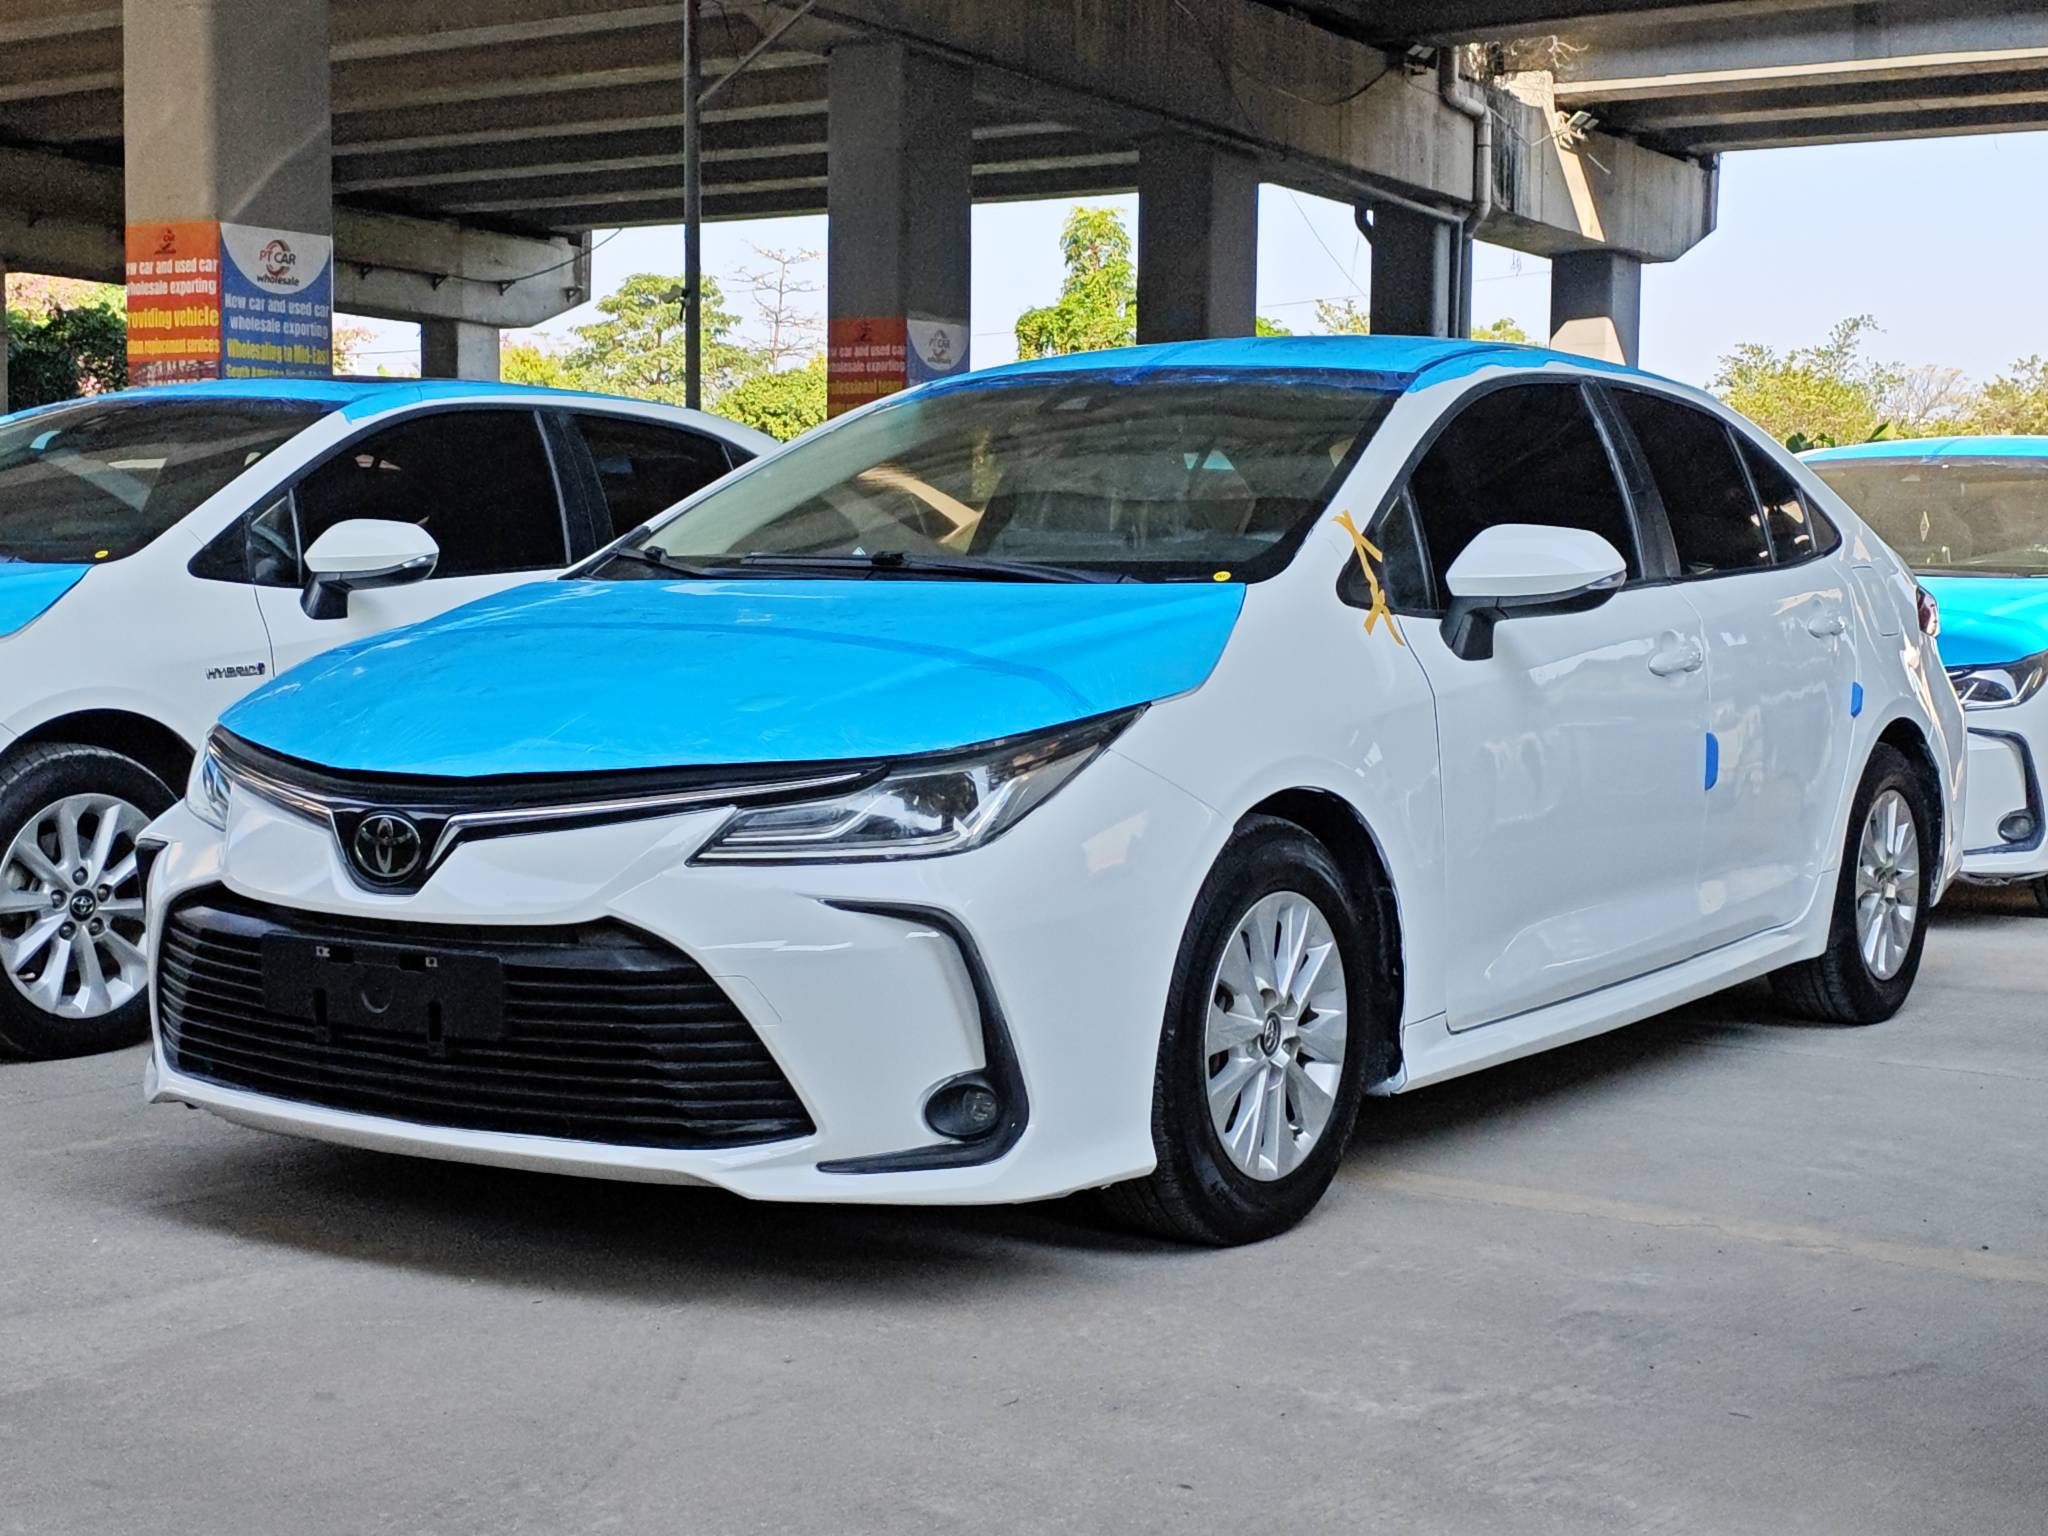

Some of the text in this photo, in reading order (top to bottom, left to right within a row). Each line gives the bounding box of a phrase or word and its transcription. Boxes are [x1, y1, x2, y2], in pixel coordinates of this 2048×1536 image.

[139, 261, 154, 274] car
[156, 259, 173, 274] and
[175, 258, 197, 273] used
[199, 258, 218, 273] car
[274, 252, 296, 265] CAR
[127, 277, 217, 296] holesale exporting
[257, 274, 299, 286] wholesale
[224, 293, 329, 318] New car and used car
[127, 305, 219, 330] roviding vehicle
[230, 315, 328, 339] wholesale exporting
[187, 336, 219, 353] services
[227, 338, 282, 363] Wholesaling
[206, 665, 257, 679] HYBRID
